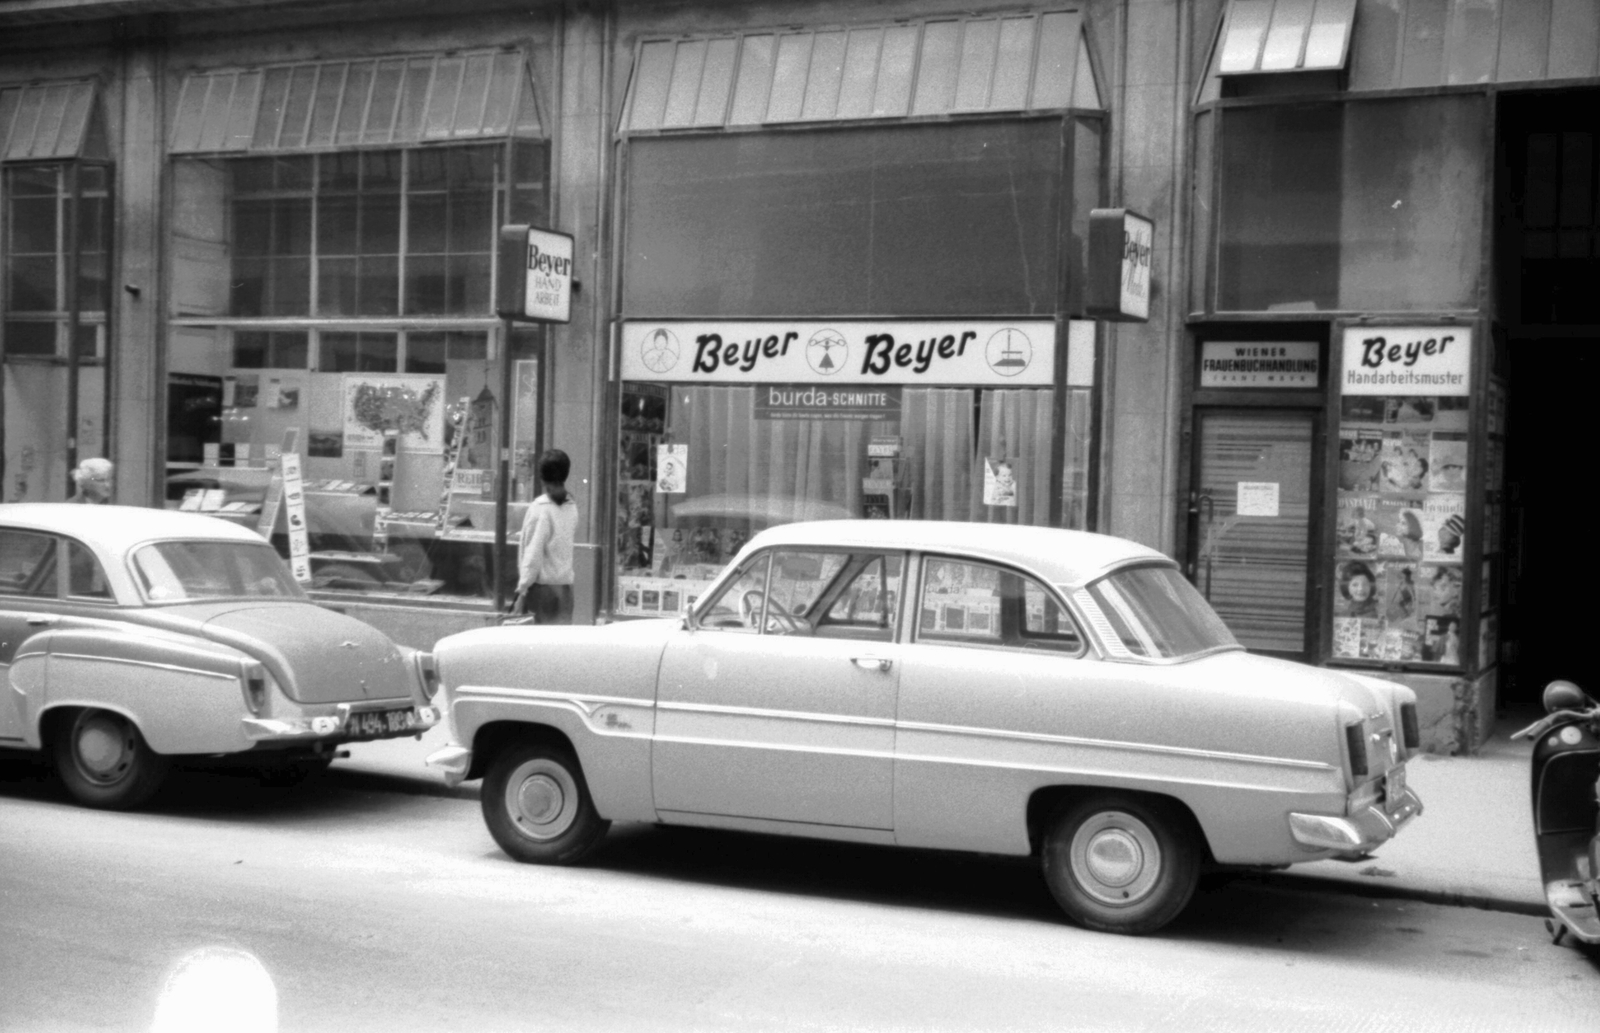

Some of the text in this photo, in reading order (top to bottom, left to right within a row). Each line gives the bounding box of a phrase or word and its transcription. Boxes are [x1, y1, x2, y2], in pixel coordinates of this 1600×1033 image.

[528, 244, 571, 277] Beyer
[536, 276, 562, 292] HAND
[692, 331, 977, 375] Beyer Beyer
[1235, 347, 1287, 357] WIENER
[1361, 336, 1455, 368] Beyer
[1203, 358, 1318, 373] FRAUENBUCHHANDLUNG
[1347, 370, 1464, 385] Handarbeitsmuster
[769, 386, 887, 406] burda-SCHNITTE
